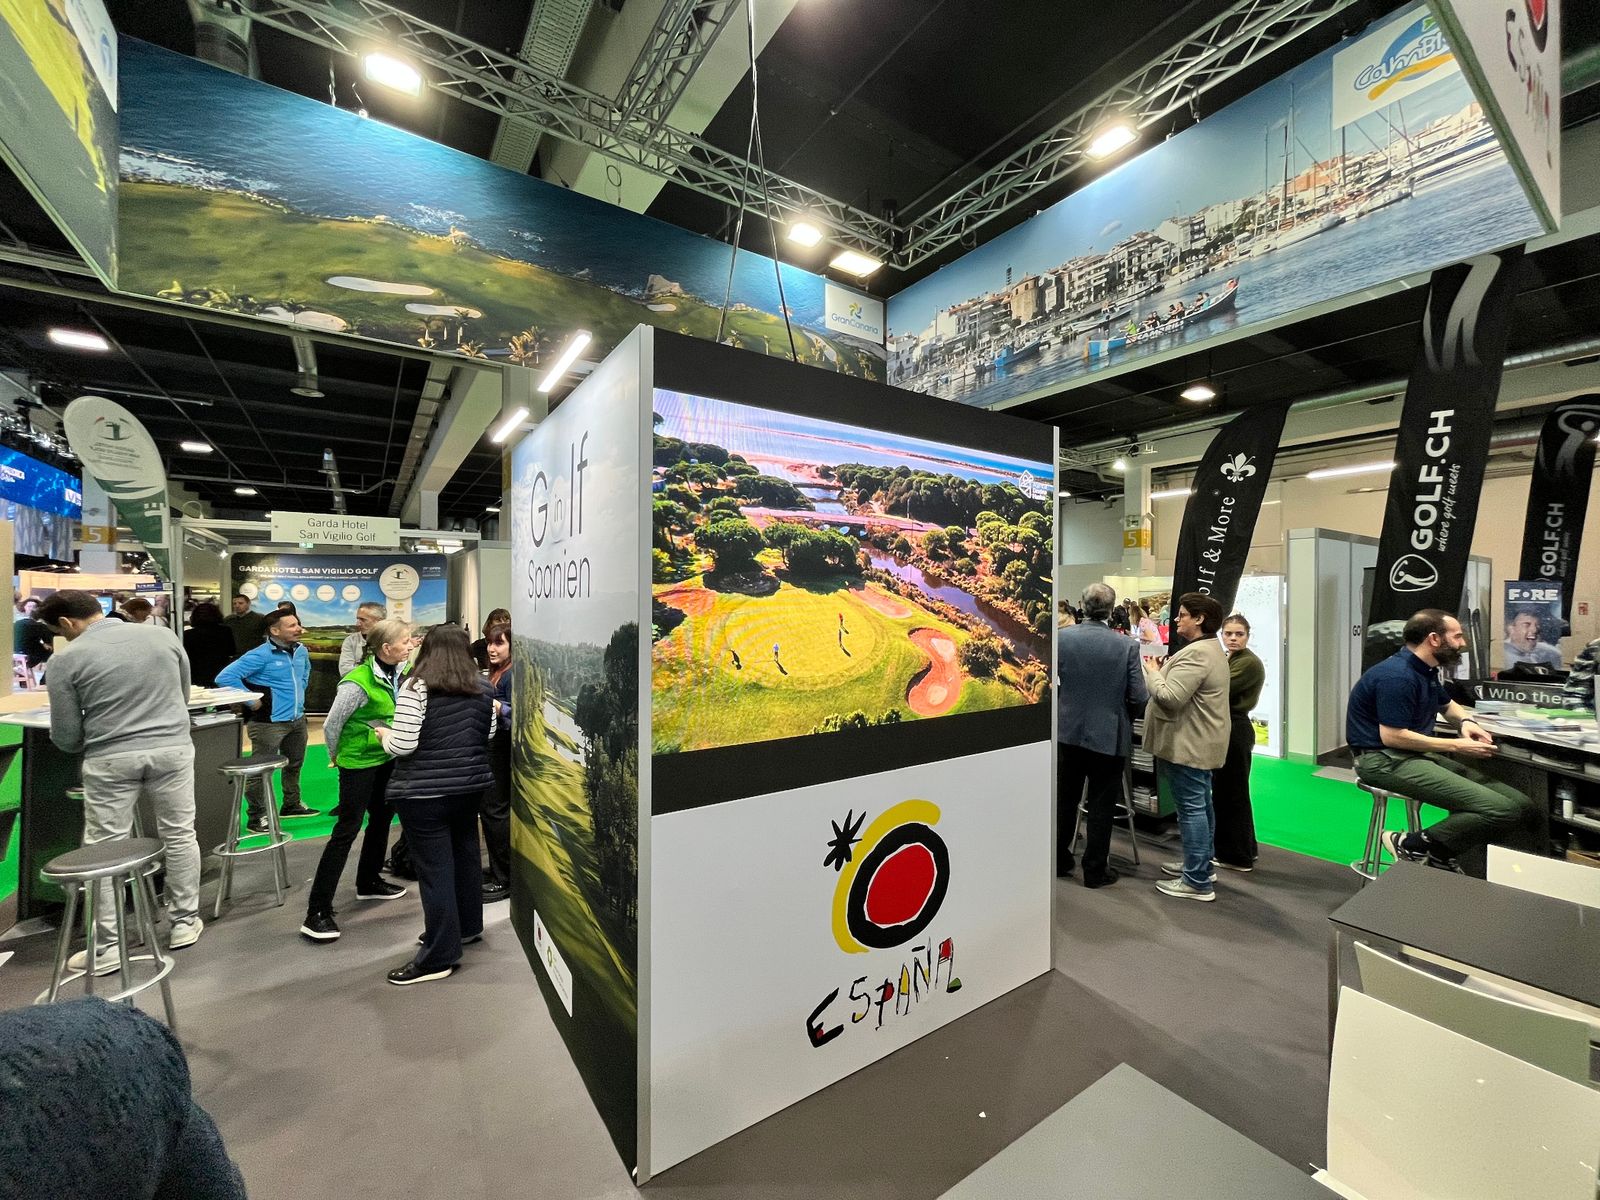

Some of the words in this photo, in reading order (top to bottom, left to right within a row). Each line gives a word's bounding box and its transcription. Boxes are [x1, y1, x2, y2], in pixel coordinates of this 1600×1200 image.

[831, 312, 879, 335] GranCanaria
[1410, 409, 1455, 550] GOLF.CH
[1441, 496, 1457, 520] golf
[307, 517, 339, 529] Garda
[342, 519, 369, 530] Hotel
[1207, 496, 1236, 544] More
[88, 527, 102, 543] 5
[299, 529, 320, 540] San
[322, 530, 353, 542] Vigilio
[355, 532, 377, 542] Golf
[1127, 530, 1137, 547] 5
[1540, 503, 1565, 577] GOLF.CH
[1202, 548, 1222, 563] &
[238, 565, 271, 573] GARDA
[272, 566, 301, 574] HOTEL
[302, 567, 321, 575] SAN
[322, 567, 354, 575] VIGILIO
[527, 548, 591, 613] Spanien
[1197, 565, 1217, 597] olf
[1488, 687, 1527, 702] Who
